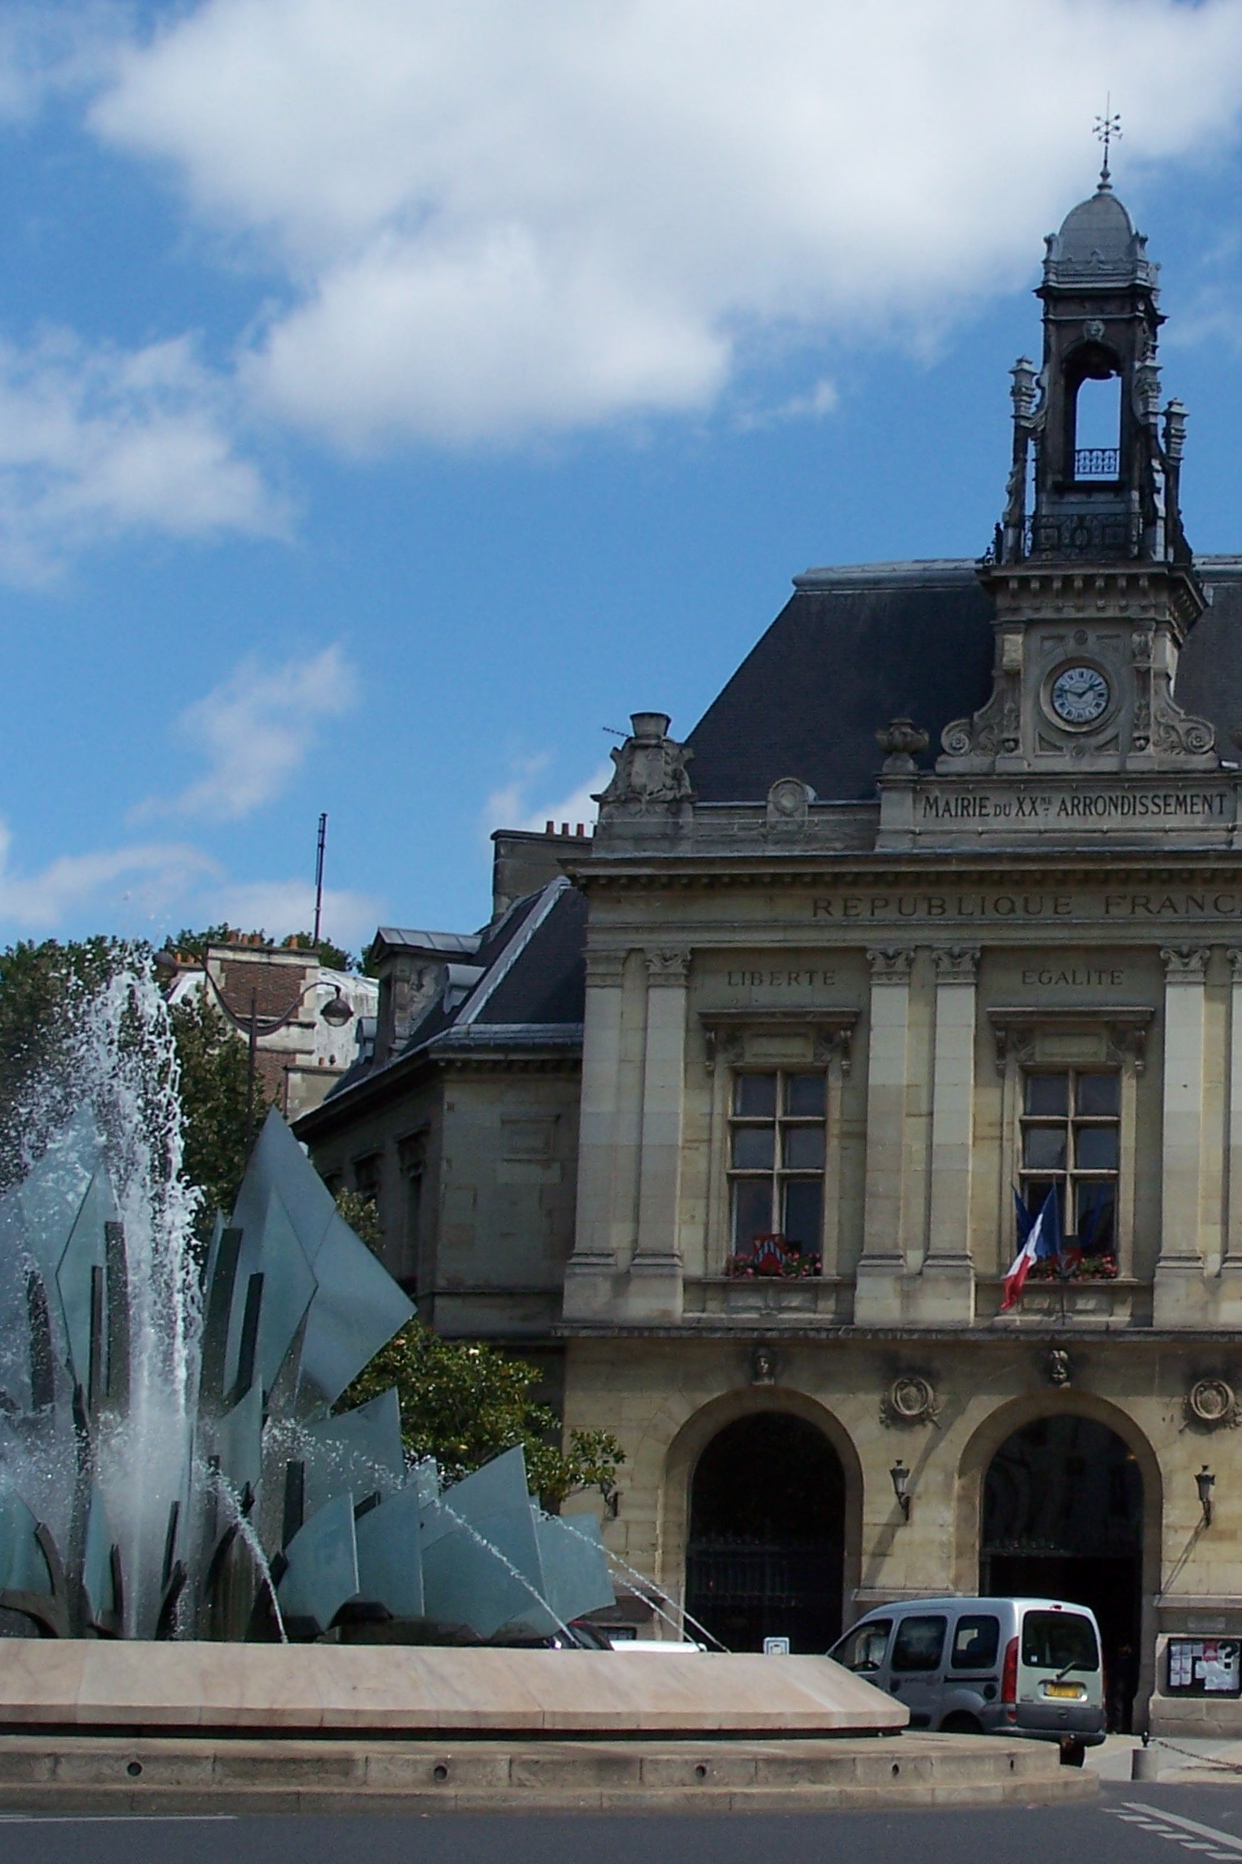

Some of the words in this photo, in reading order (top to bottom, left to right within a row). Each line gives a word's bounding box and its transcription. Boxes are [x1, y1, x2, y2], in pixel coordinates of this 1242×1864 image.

[923, 796, 991, 818] MAIRIE
[993, 803, 1012, 817] DU
[1057, 793, 1227, 817] ARRONDISSEMENT
[812, 895, 1073, 918] REPUBLIQUE
[727, 970, 836, 987] LIBERTE
[1021, 969, 1124, 986] EGALITE
